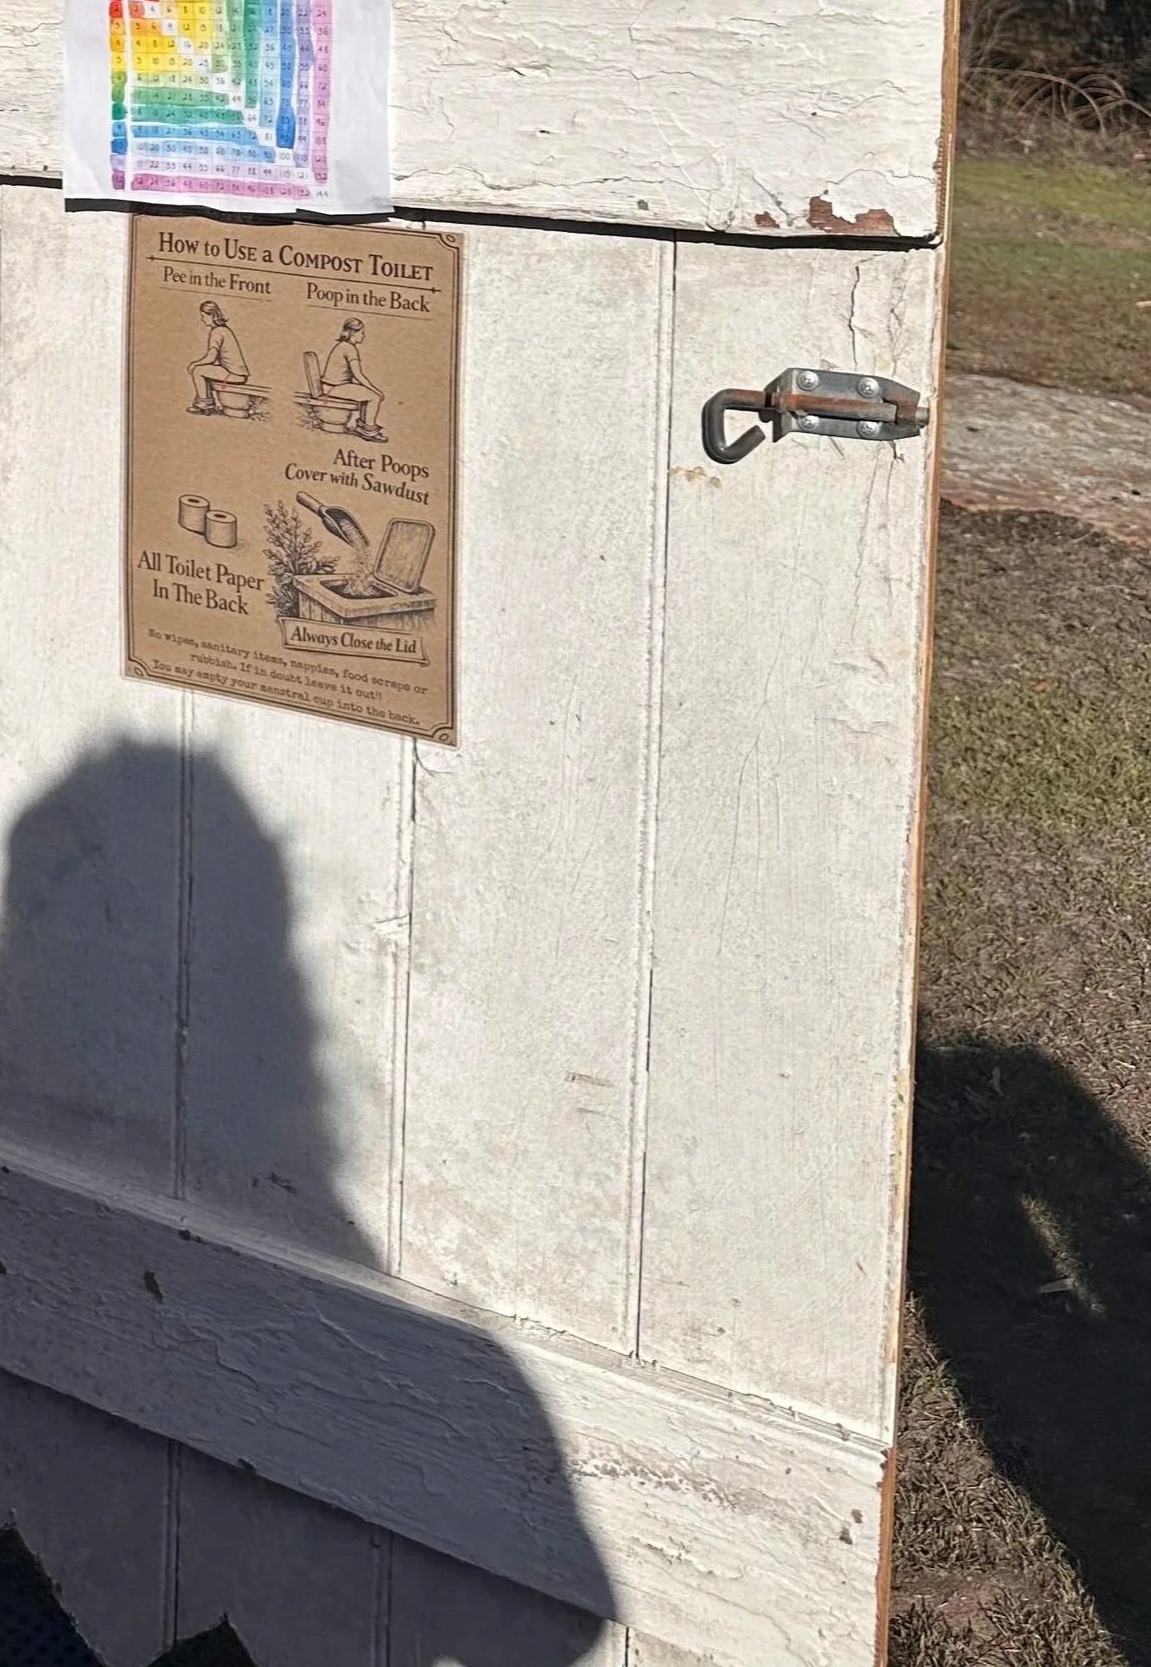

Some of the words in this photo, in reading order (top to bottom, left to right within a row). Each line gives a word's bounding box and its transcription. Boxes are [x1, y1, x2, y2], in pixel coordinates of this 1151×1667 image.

[204, 240, 220, 257] to
[262, 249, 274, 263] a
[163, 265, 187, 284] Pee
[189, 270, 202, 286] in
[205, 272, 227, 288] the
[229, 273, 272, 294] Front
[306, 282, 344, 306] Poop
[346, 288, 359, 304] in
[363, 290, 387, 307] the
[390, 291, 431, 312] Back
[333, 448, 376, 470] After
[380, 454, 430, 482] Poops
[284, 462, 328, 482] Cover
[329, 472, 358, 488] with
[361, 472, 431, 506] Sawdust
[137, 550, 161, 572] All
[165, 554, 212, 582] Toilet
[215, 563, 265, 593] Paper
[152, 578, 169, 600] In
[172, 582, 203, 606] The
[205, 588, 249, 615] Back
[290, 625, 338, 648] Always
[340, 631, 373, 650] Close
[374, 637, 393, 652] the
[395, 637, 417, 654] Lid
[148, 628, 162, 640] No
[164, 633, 199, 649] wipes,
[200, 641, 250, 661] sanitary
[252, 650, 287, 668] items,
[290, 659, 339, 678] nappies,
[342, 668, 369, 683] food
[371, 675, 411, 692] scraps
[413, 684, 429, 695] or
[190, 653, 237, 670] rubbish.
[239, 661, 251, 673] If
[253, 664, 267, 677] in
[269, 668, 302, 685] doubt
[305, 677, 337, 693] leave
[339, 683, 353, 695] it
[152, 658, 172, 672] You
[174, 665, 195, 678] may
[196, 669, 229, 686] empty
[230, 676, 258, 690] your
[312, 694, 334, 709] cup
[336, 699, 364, 714] into
[365, 706, 386, 717] the
[387, 710, 421, 726] back.
